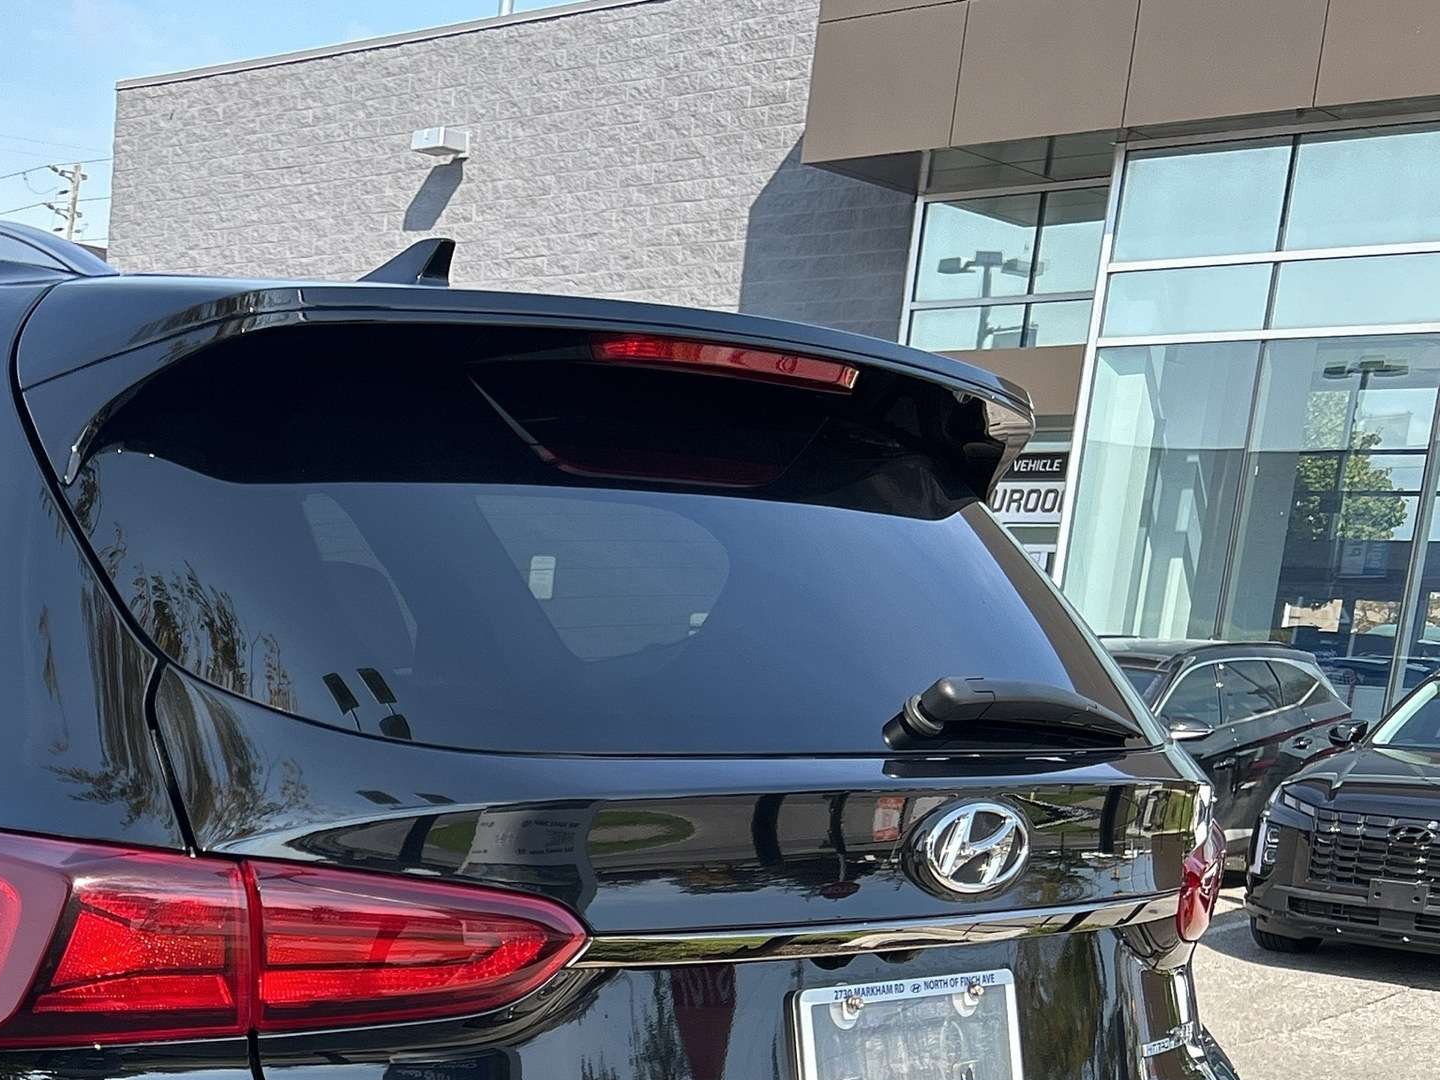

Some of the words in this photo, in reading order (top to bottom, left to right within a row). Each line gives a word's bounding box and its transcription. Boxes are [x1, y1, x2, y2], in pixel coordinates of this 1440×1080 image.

[1013, 459, 1062, 472] VEHICLE
[853, 983, 893, 997] MARKHAM
[894, 983, 905, 994] RD
[923, 979, 949, 990] NORTH
[949, 977, 960, 989] OF
[960, 975, 980, 987] FINCH
[982, 973, 995, 984] AVE
